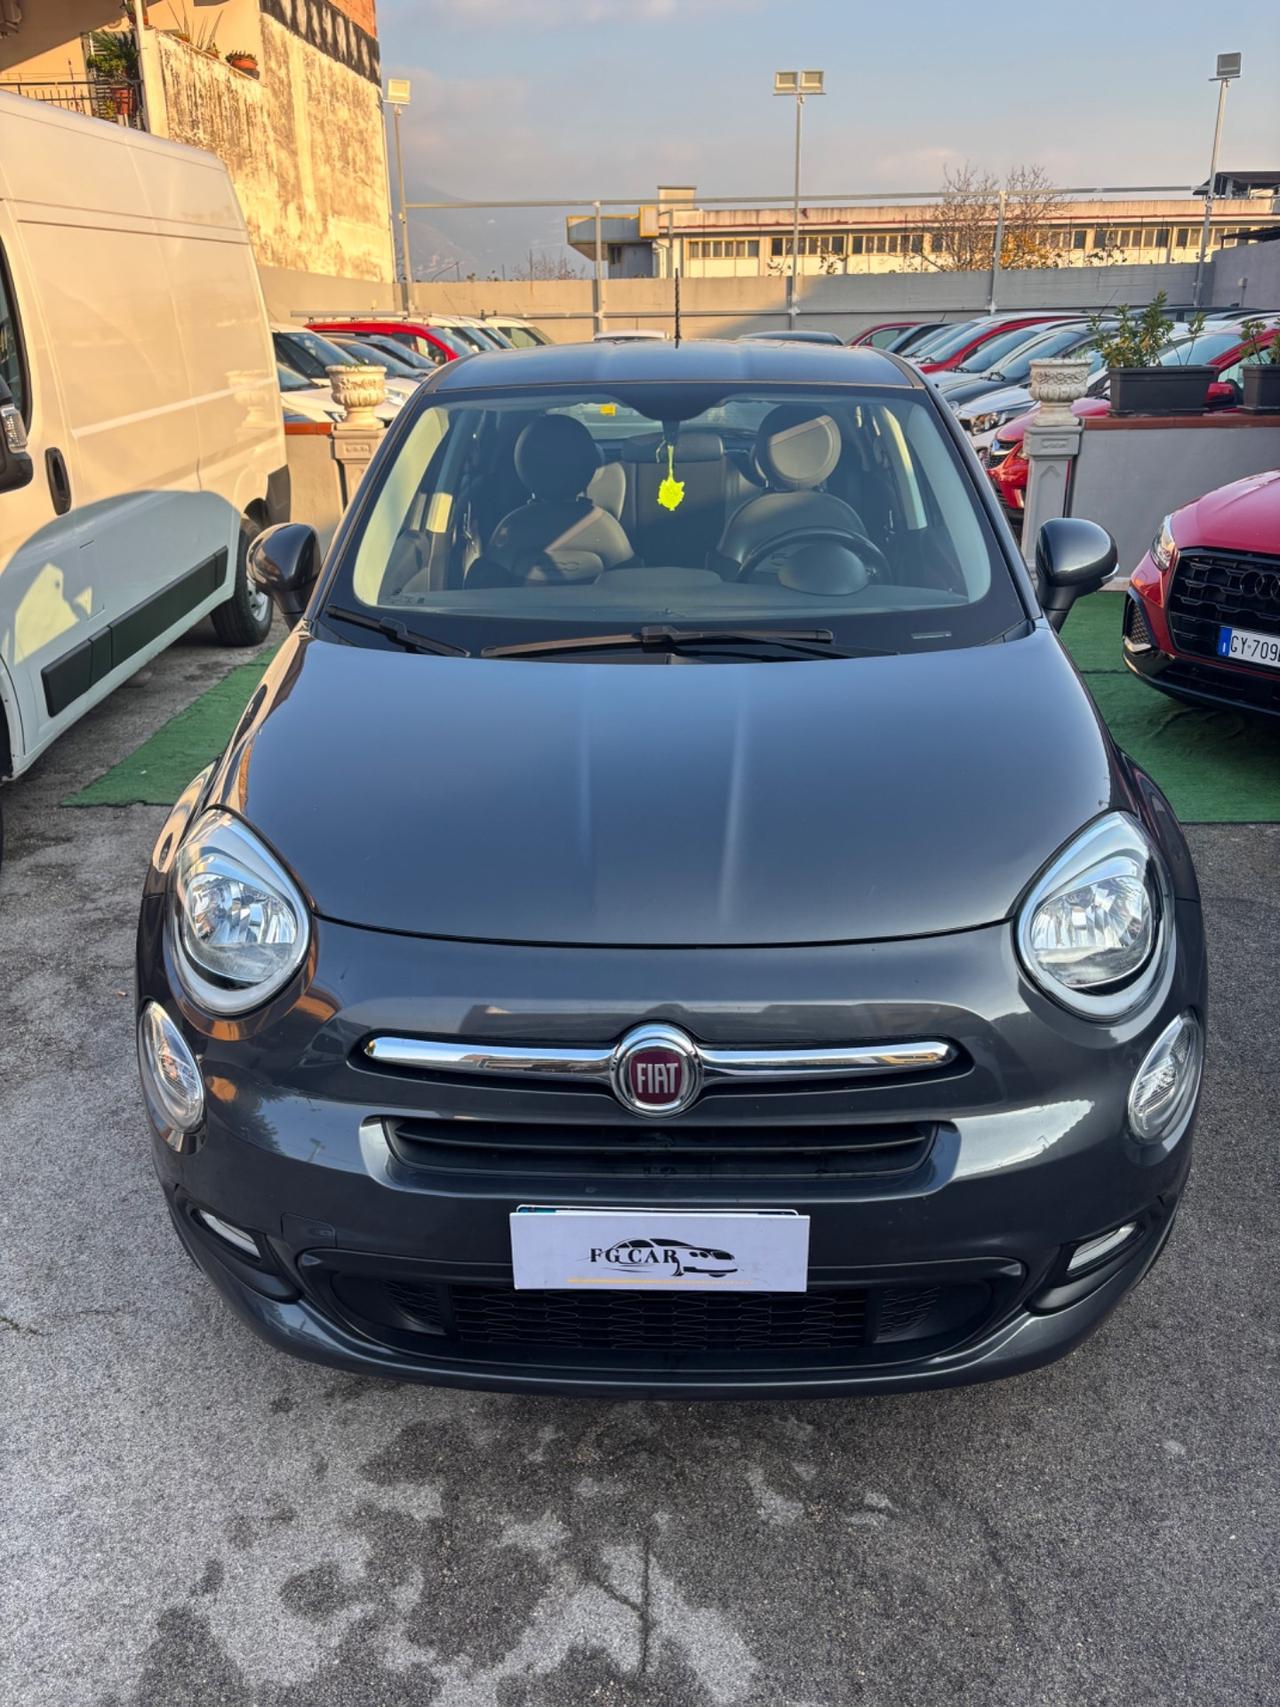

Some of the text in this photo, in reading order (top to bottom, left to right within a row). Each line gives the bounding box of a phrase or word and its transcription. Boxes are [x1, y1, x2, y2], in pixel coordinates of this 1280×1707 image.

[636, 1062, 679, 1094] FIAT
[590, 1247, 679, 1264] FG CAR
